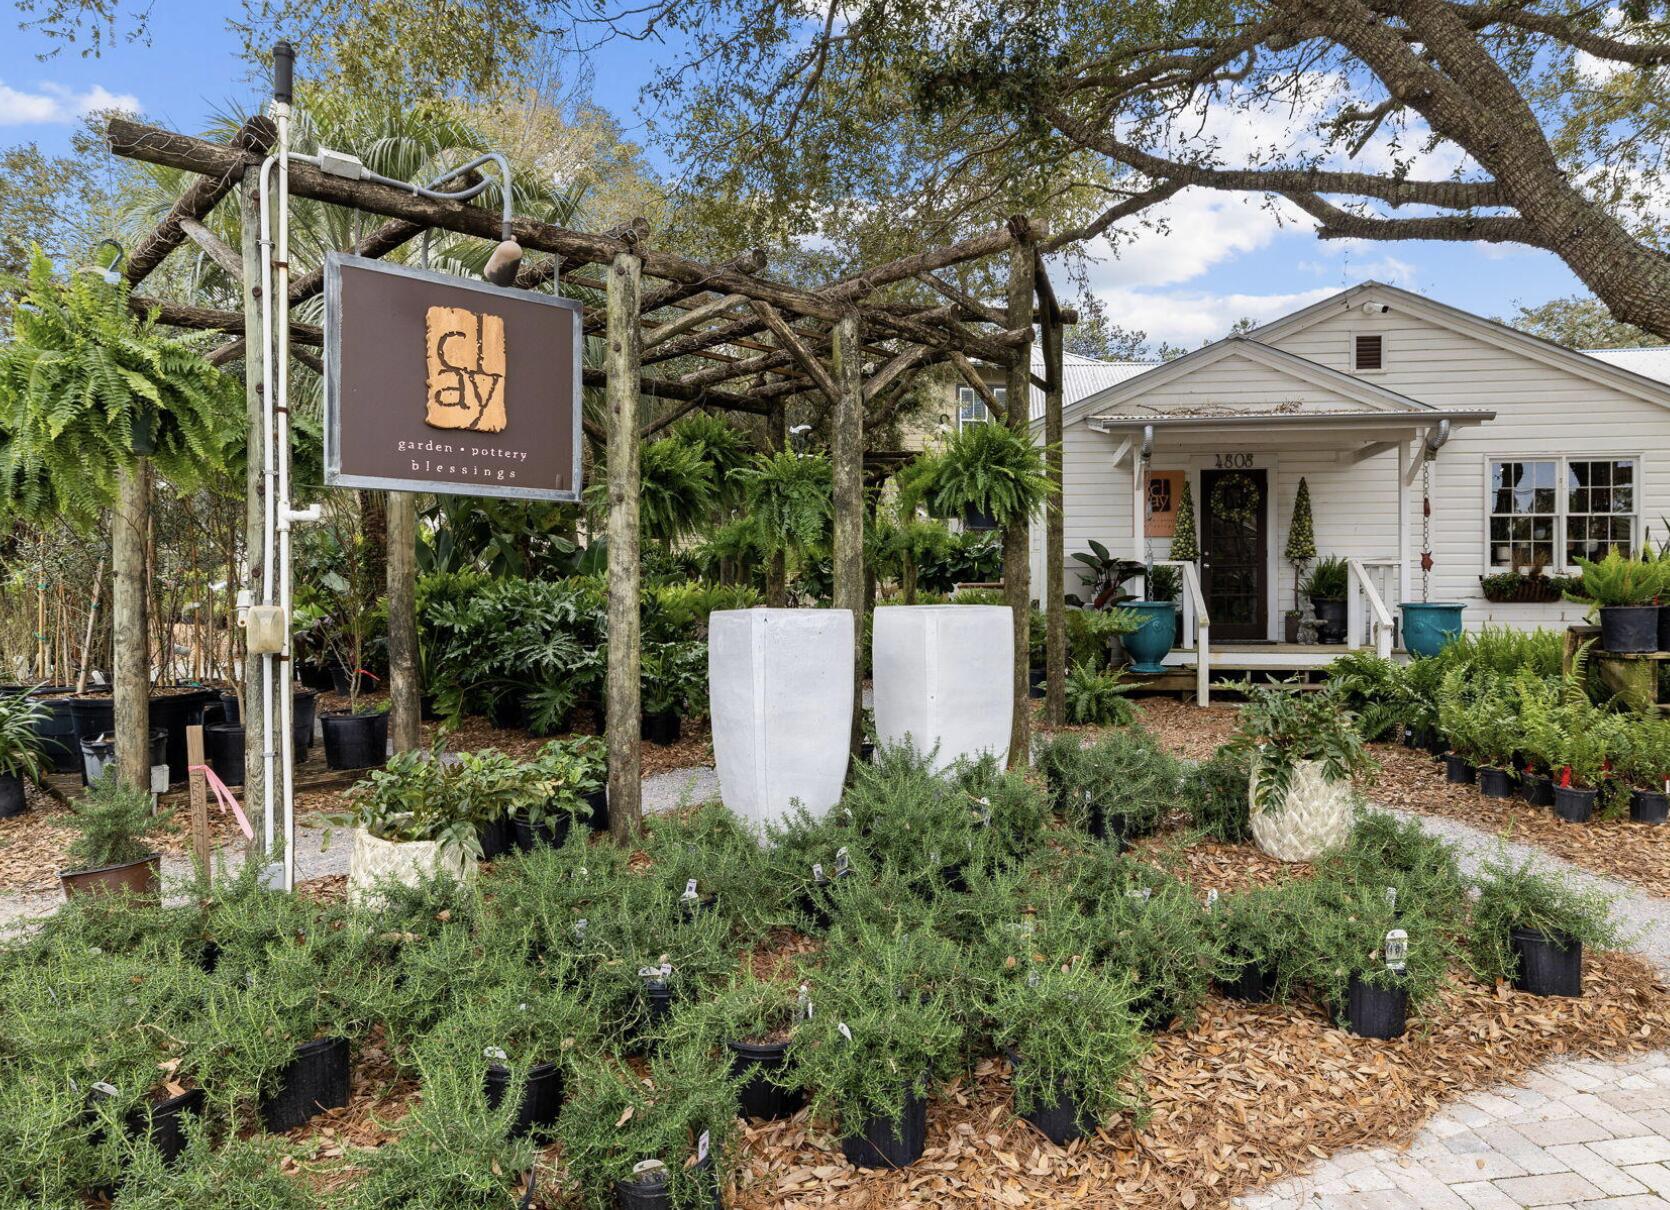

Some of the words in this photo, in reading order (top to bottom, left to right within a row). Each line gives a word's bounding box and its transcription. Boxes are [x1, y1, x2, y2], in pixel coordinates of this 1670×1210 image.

[397, 440, 454, 452] garden
[471, 446, 528, 462] pottery
[411, 459, 517, 480] blessings
